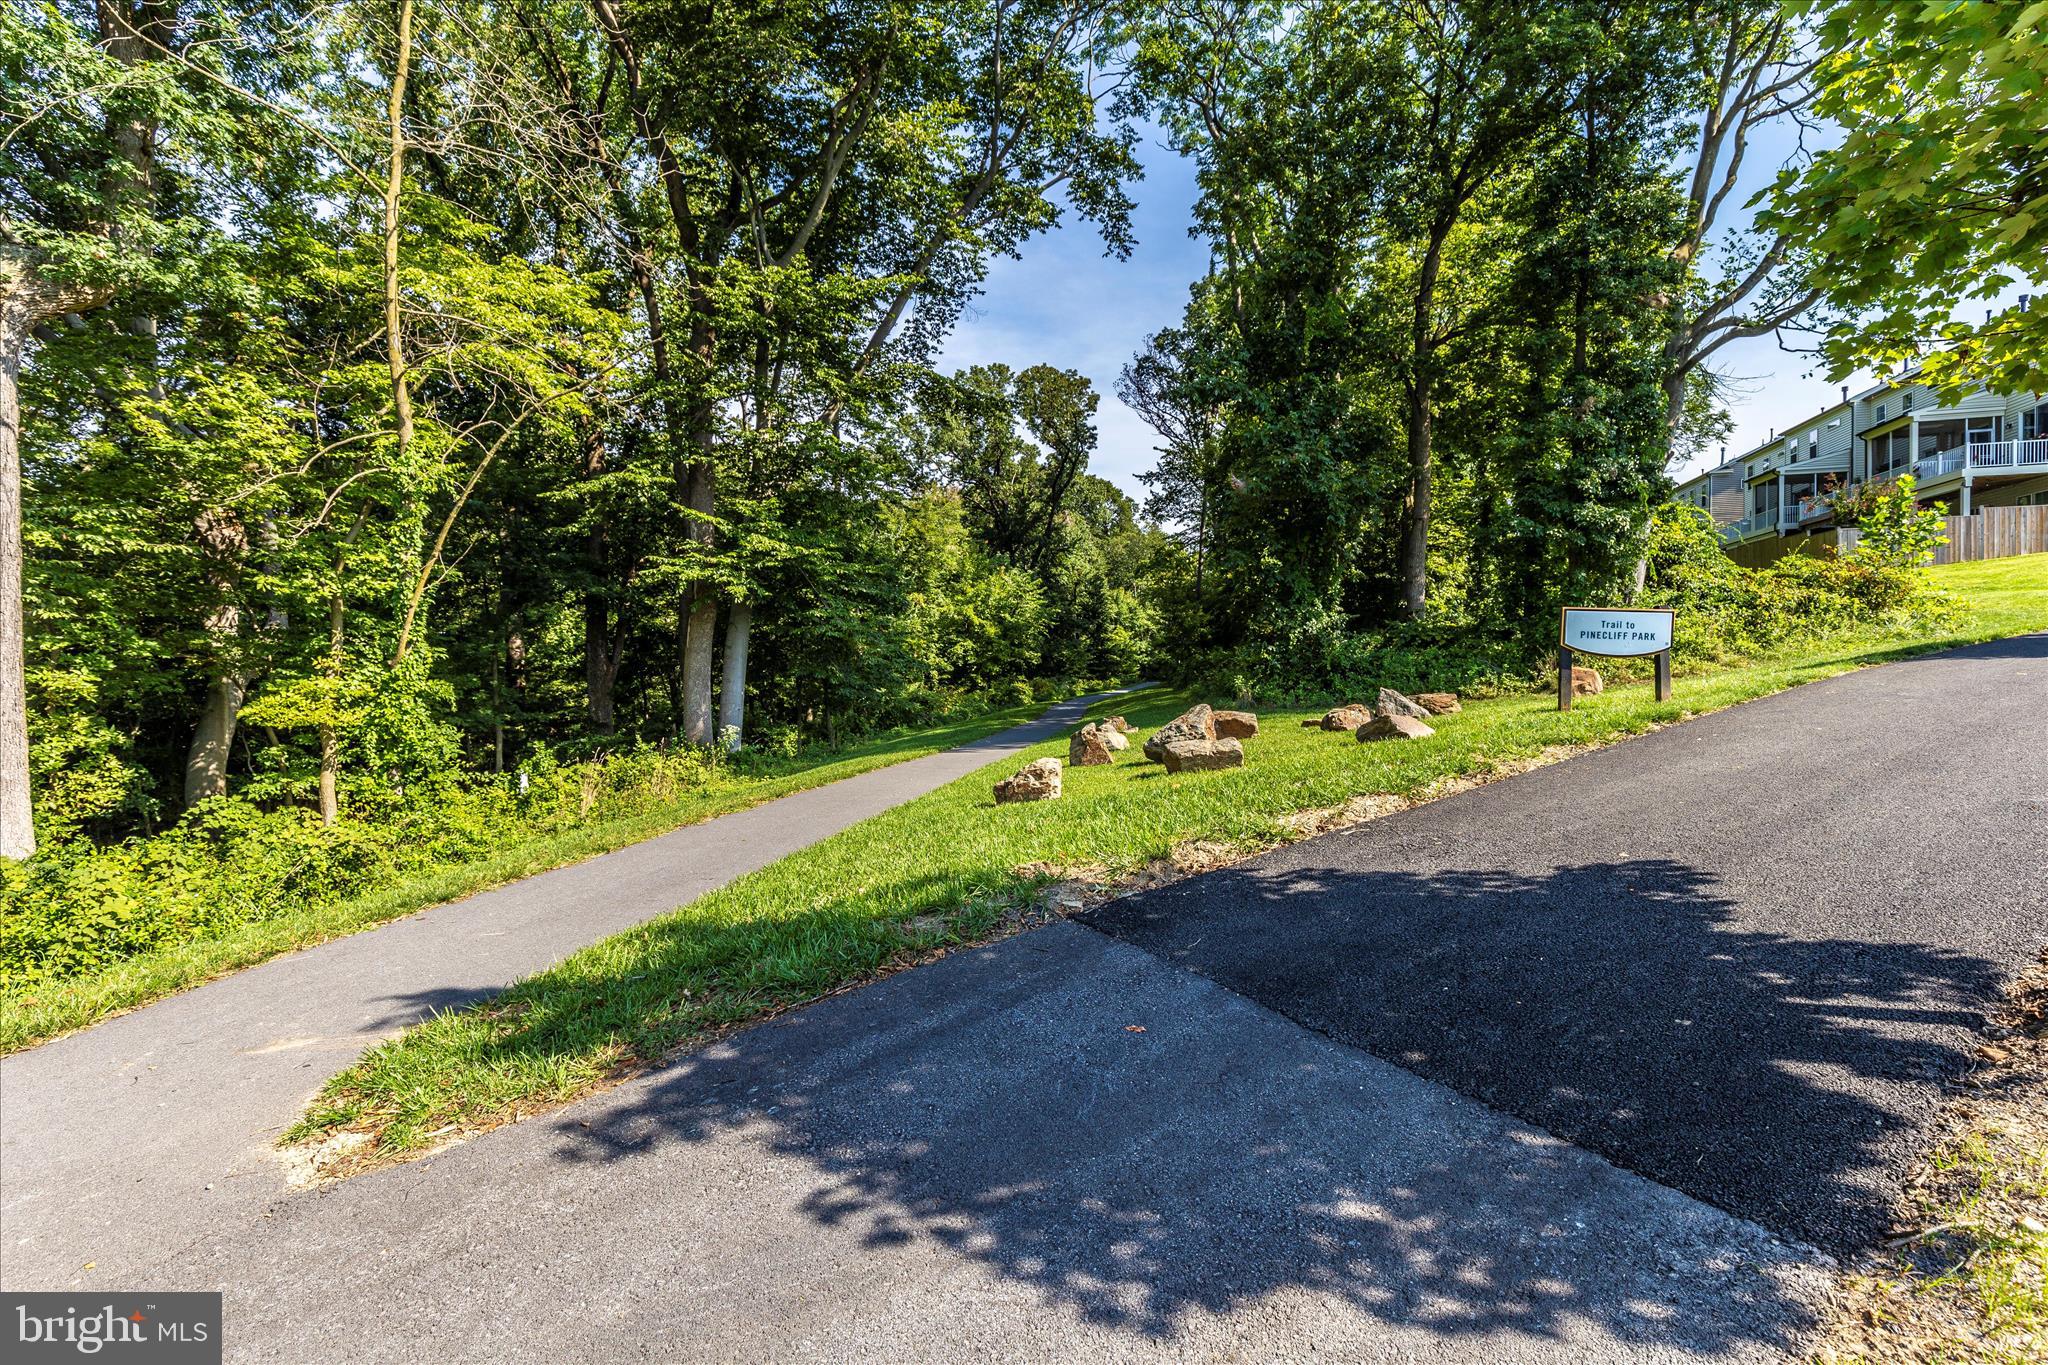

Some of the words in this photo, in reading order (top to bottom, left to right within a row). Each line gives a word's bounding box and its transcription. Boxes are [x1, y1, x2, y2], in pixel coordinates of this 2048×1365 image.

[1601, 620, 1622, 629] Trail
[1626, 621, 1635, 629] to
[1580, 631, 1628, 640] PINECLIFF
[1632, 632, 1656, 641] PARK
